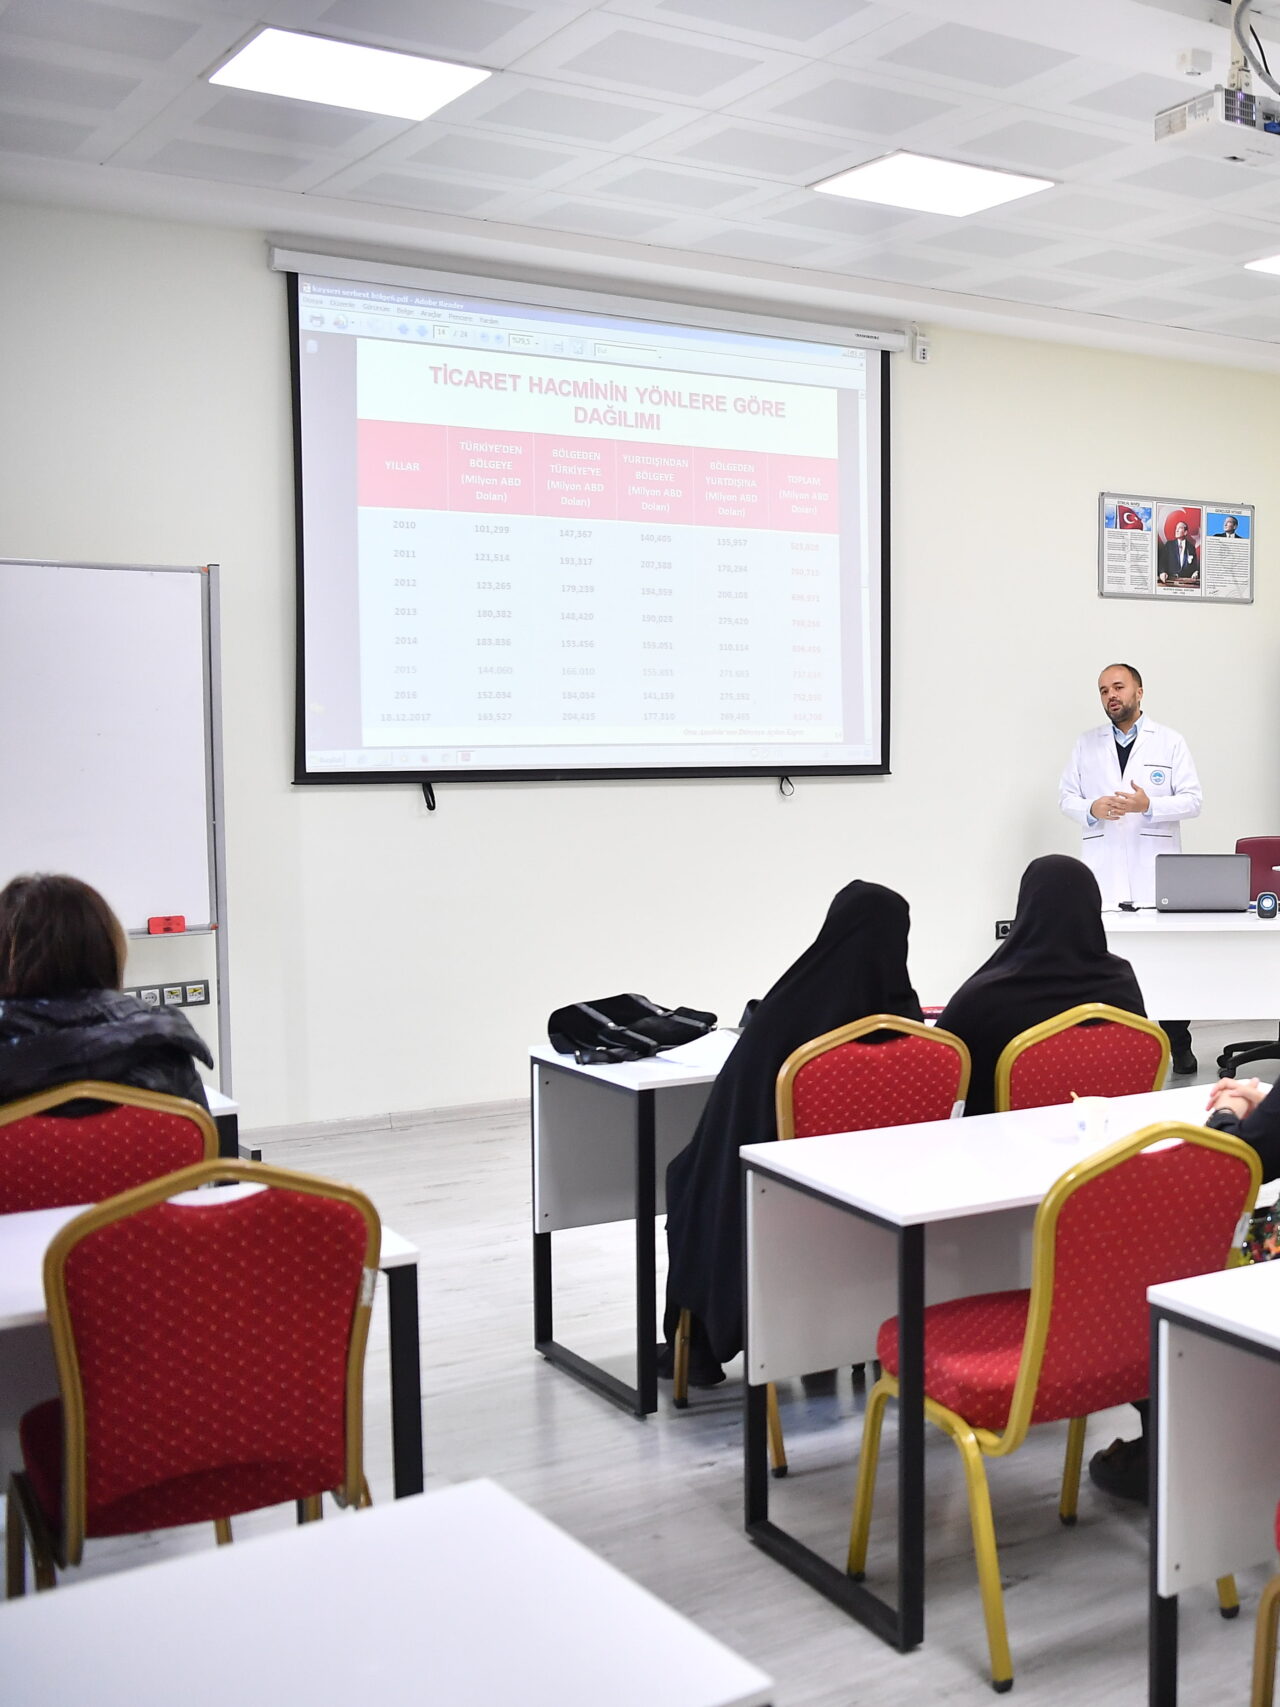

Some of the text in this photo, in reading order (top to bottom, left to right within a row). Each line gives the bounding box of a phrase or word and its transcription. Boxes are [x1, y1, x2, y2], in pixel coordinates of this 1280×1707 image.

[429, 364, 786, 418] TİCARET HACMİNİN YÖNLERE GÖRE
[574, 405, 660, 430] DAĞILIMI
[552, 448, 601, 461] BÖLGEDEN
[384, 460, 420, 471] YILLAR
[469, 457, 513, 470] BÖLGEYE
[501, 477, 521, 486] ABD
[586, 481, 604, 491] ABD
[662, 488, 682, 497] ABD
[393, 520, 416, 529] 2010
[474, 525, 510, 535] 101,299
[394, 550, 416, 558] 2011
[394, 579, 416, 587] 2012
[395, 608, 416, 616] 2013
[394, 666, 416, 674] 2015
